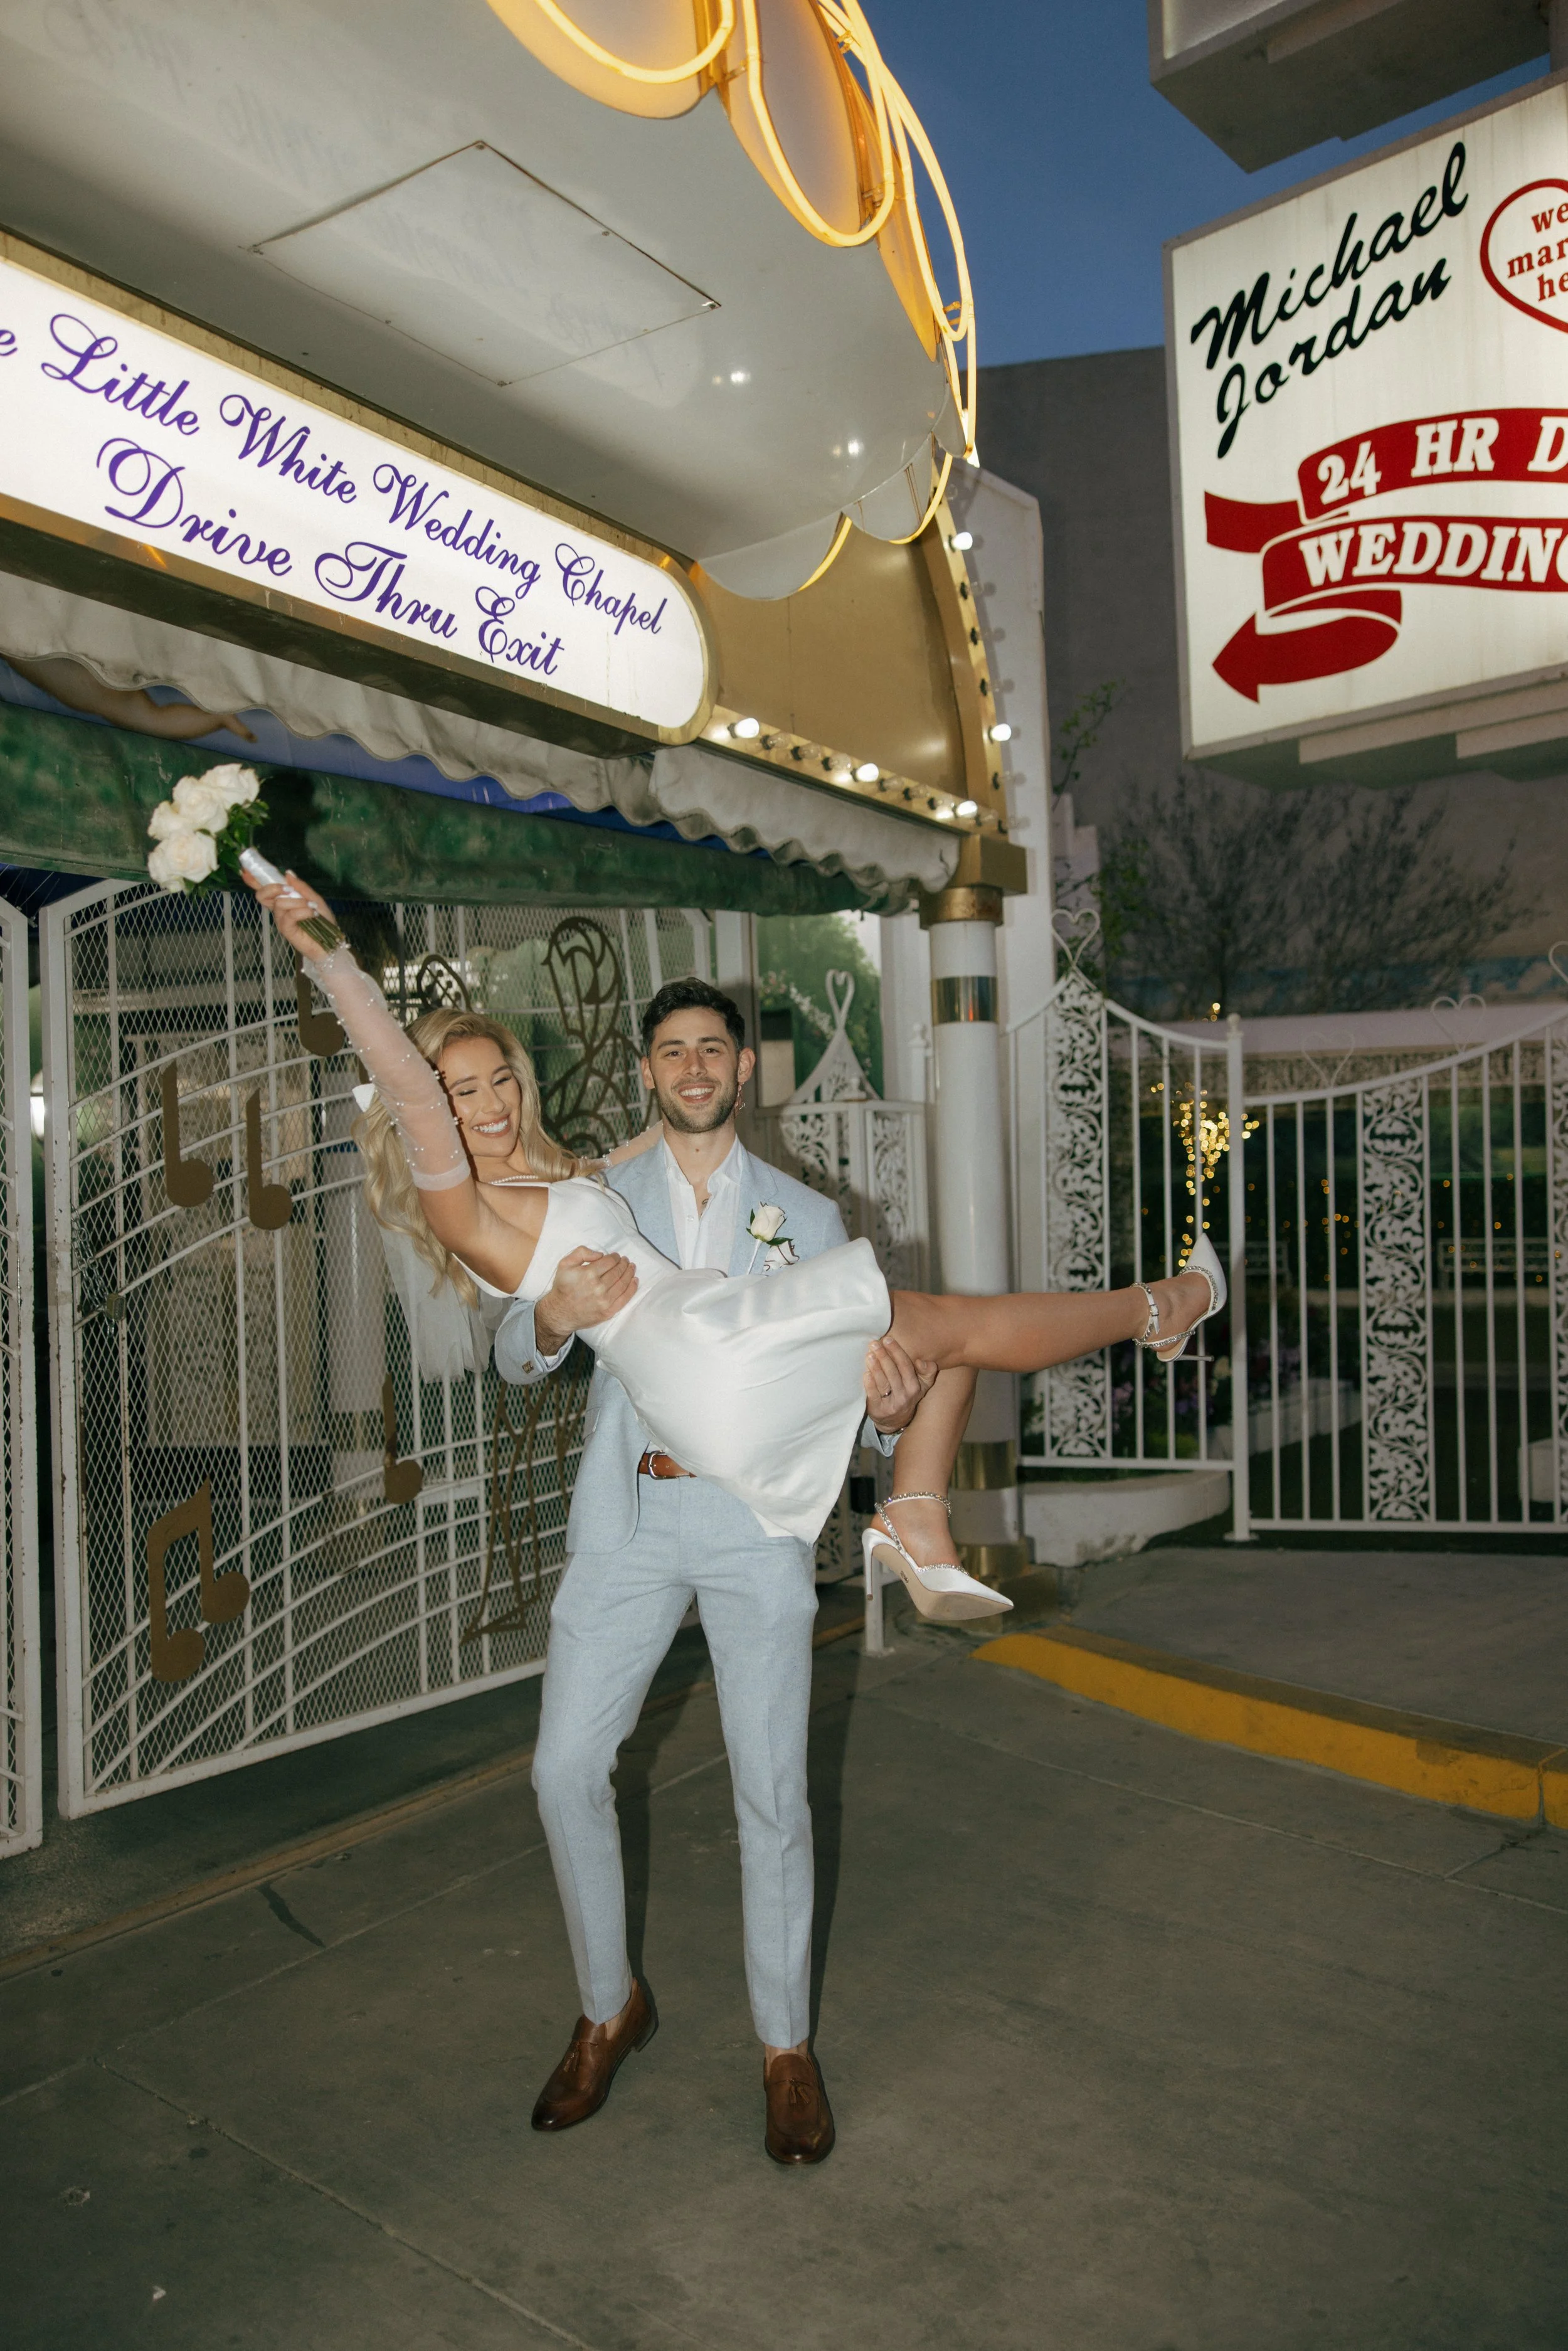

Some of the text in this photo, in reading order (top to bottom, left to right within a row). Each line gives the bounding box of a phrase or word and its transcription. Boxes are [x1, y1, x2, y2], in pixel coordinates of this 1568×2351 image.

[1191, 142, 1468, 369] Michael
[1217, 258, 1451, 459] Jordan
[41, 314, 199, 435] Little
[220, 395, 357, 504] White
[373, 464, 541, 600] Wedding
[555, 543, 667, 635] Chapel
[97, 438, 564, 676] Drive Thru Exit
[1317, 441, 1382, 504] 24
[1411, 417, 1500, 477] HR
